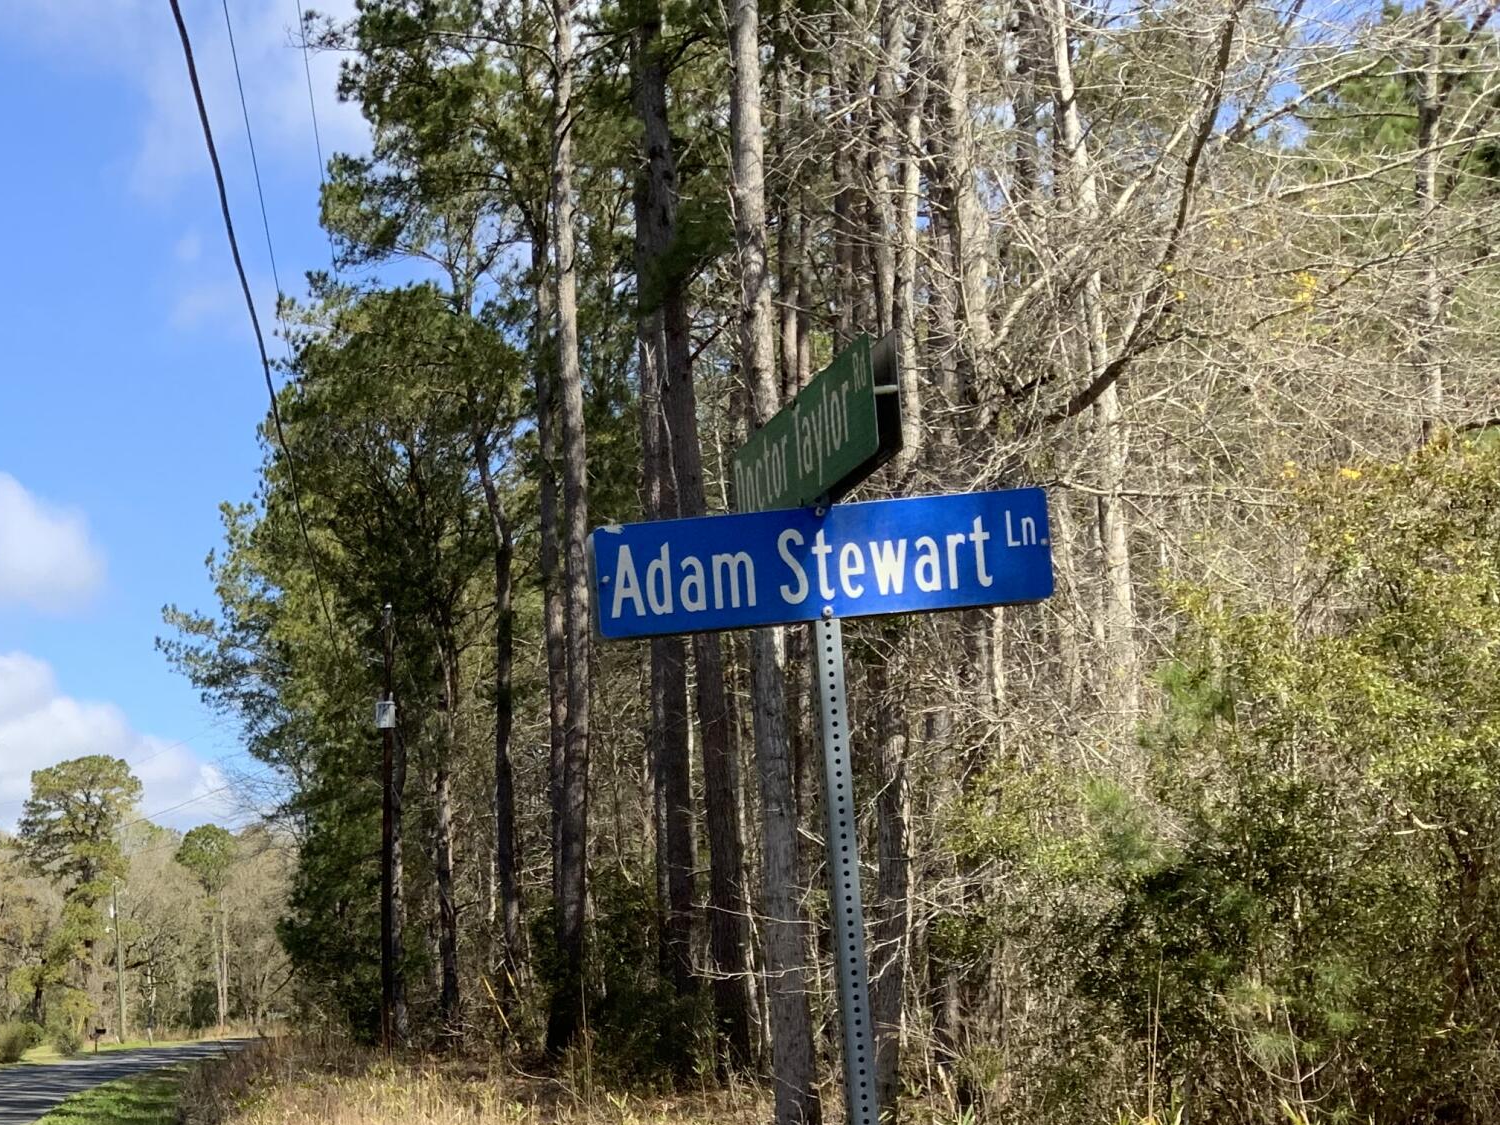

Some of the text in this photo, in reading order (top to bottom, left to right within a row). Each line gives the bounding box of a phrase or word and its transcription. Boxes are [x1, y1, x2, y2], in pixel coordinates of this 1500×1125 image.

[734, 346, 867, 513] Doctor Taylor Rd
[611, 542, 757, 619] Adam
[777, 515, 993, 605] Stewart
